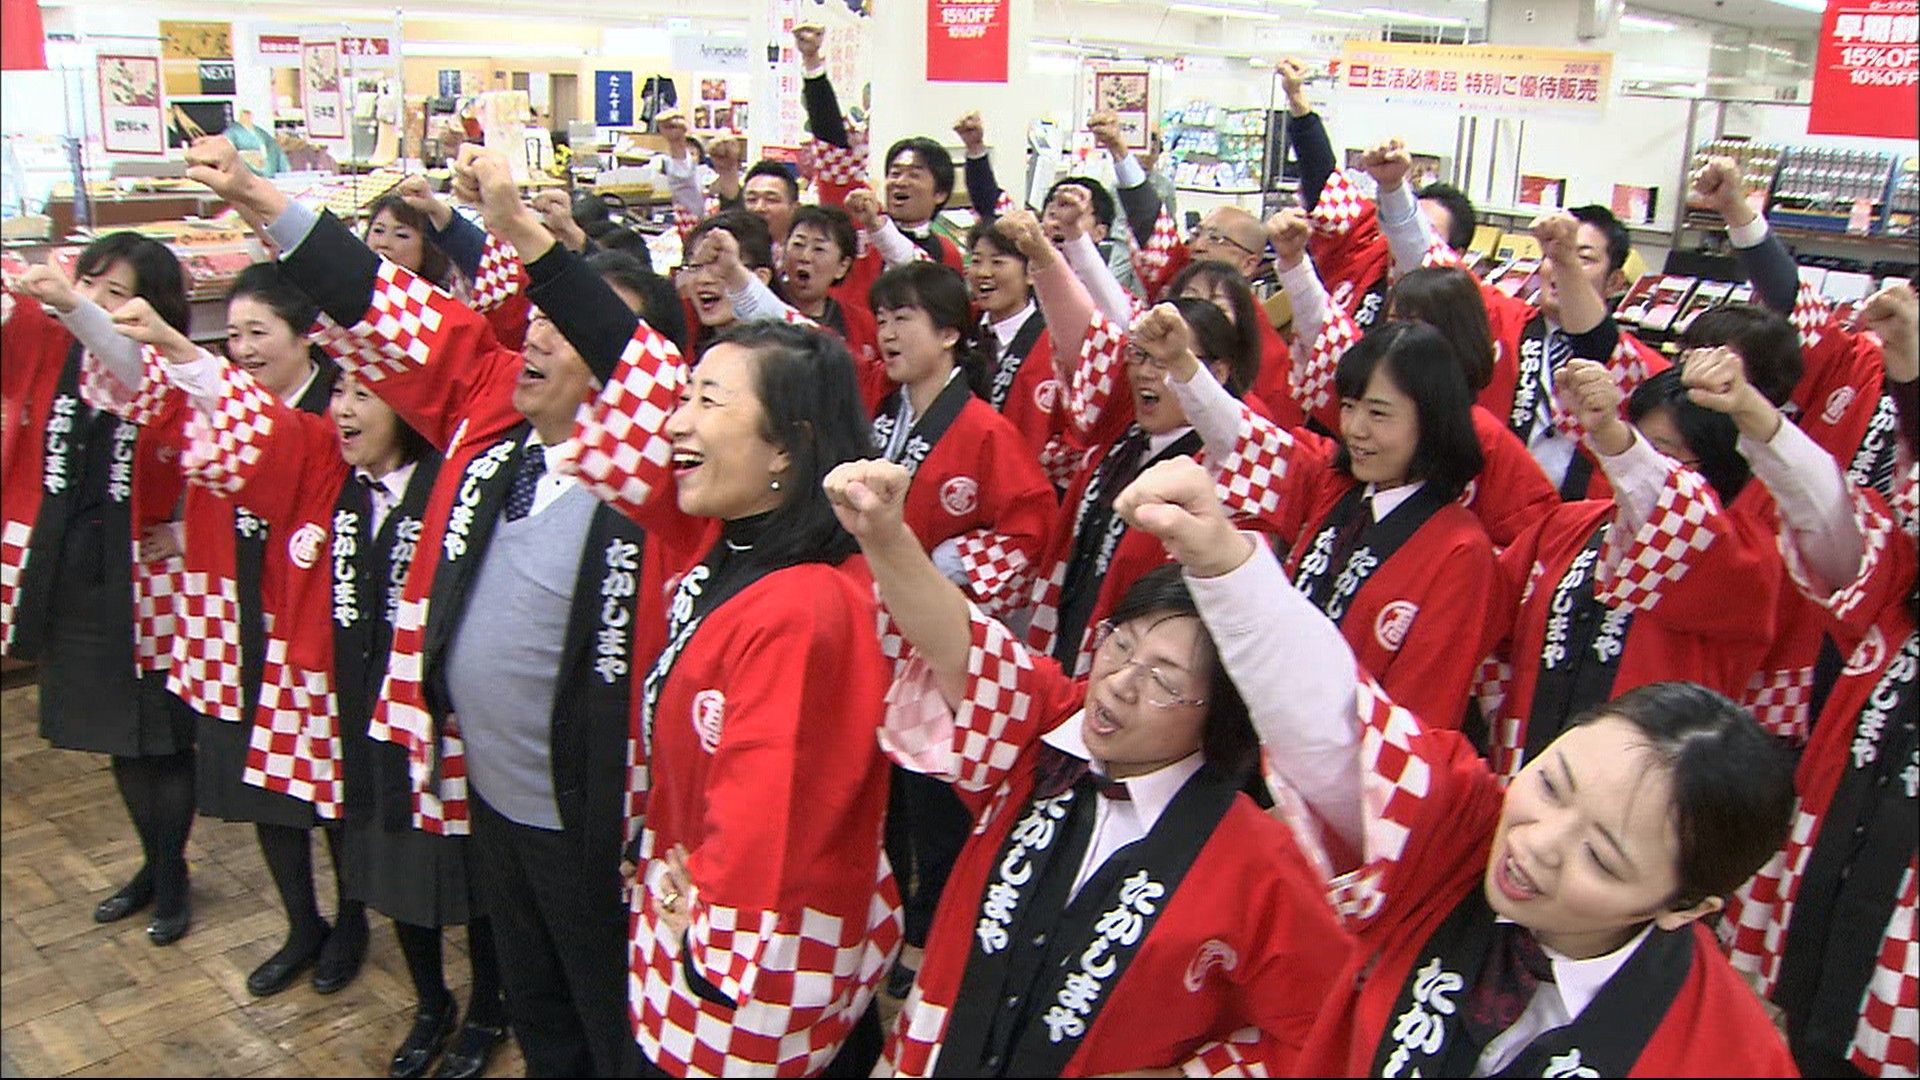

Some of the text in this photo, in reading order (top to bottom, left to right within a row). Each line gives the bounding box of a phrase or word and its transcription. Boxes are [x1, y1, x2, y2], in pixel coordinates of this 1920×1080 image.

[941, 8, 994, 23] 15%OFF
[202, 67, 234, 79] NEXT
[1371, 67, 1457, 92] 生活必需品
[1465, 72, 1599, 102] 特別ご優待販売
[1511, 338, 1542, 428] たかしまや
[44, 393, 78, 494] たかしまや
[443, 440, 516, 562] たかしまや
[332, 510, 360, 628] たかしまや
[594, 538, 640, 684] たかしまや
[1541, 549, 1598, 669] たかしまや
[1043, 870, 1165, 1043] たかしまや
